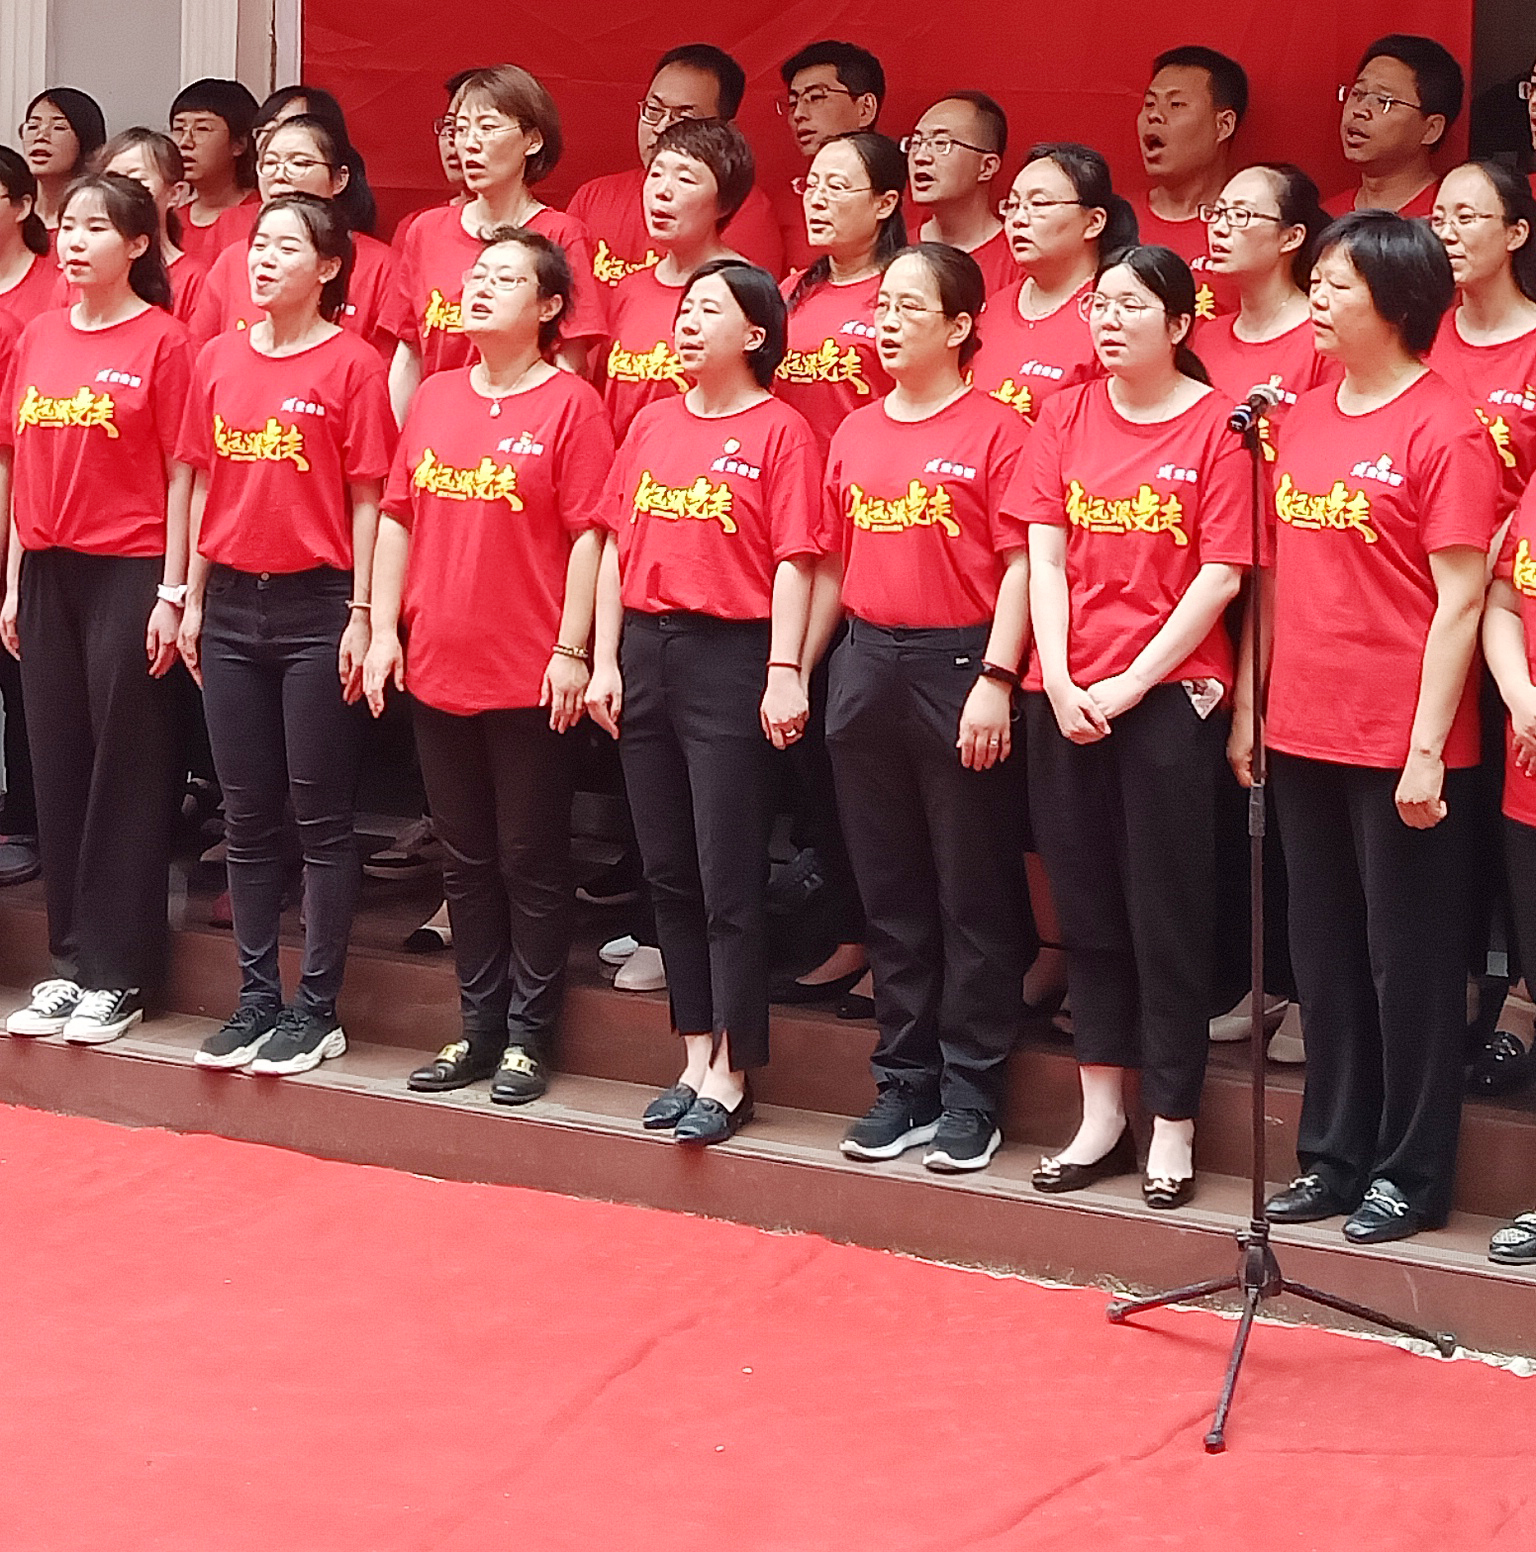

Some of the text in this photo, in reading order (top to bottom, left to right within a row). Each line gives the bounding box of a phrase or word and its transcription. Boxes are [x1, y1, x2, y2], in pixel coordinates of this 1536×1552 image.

[18, 384, 119, 438] 永远跟党走
[414, 448, 523, 512] 永远跟党走
[631, 469, 736, 534] 永远跟党走
[848, 478, 960, 538] 永远跟党走
[1066, 479, 1188, 546] 永远跟党走
